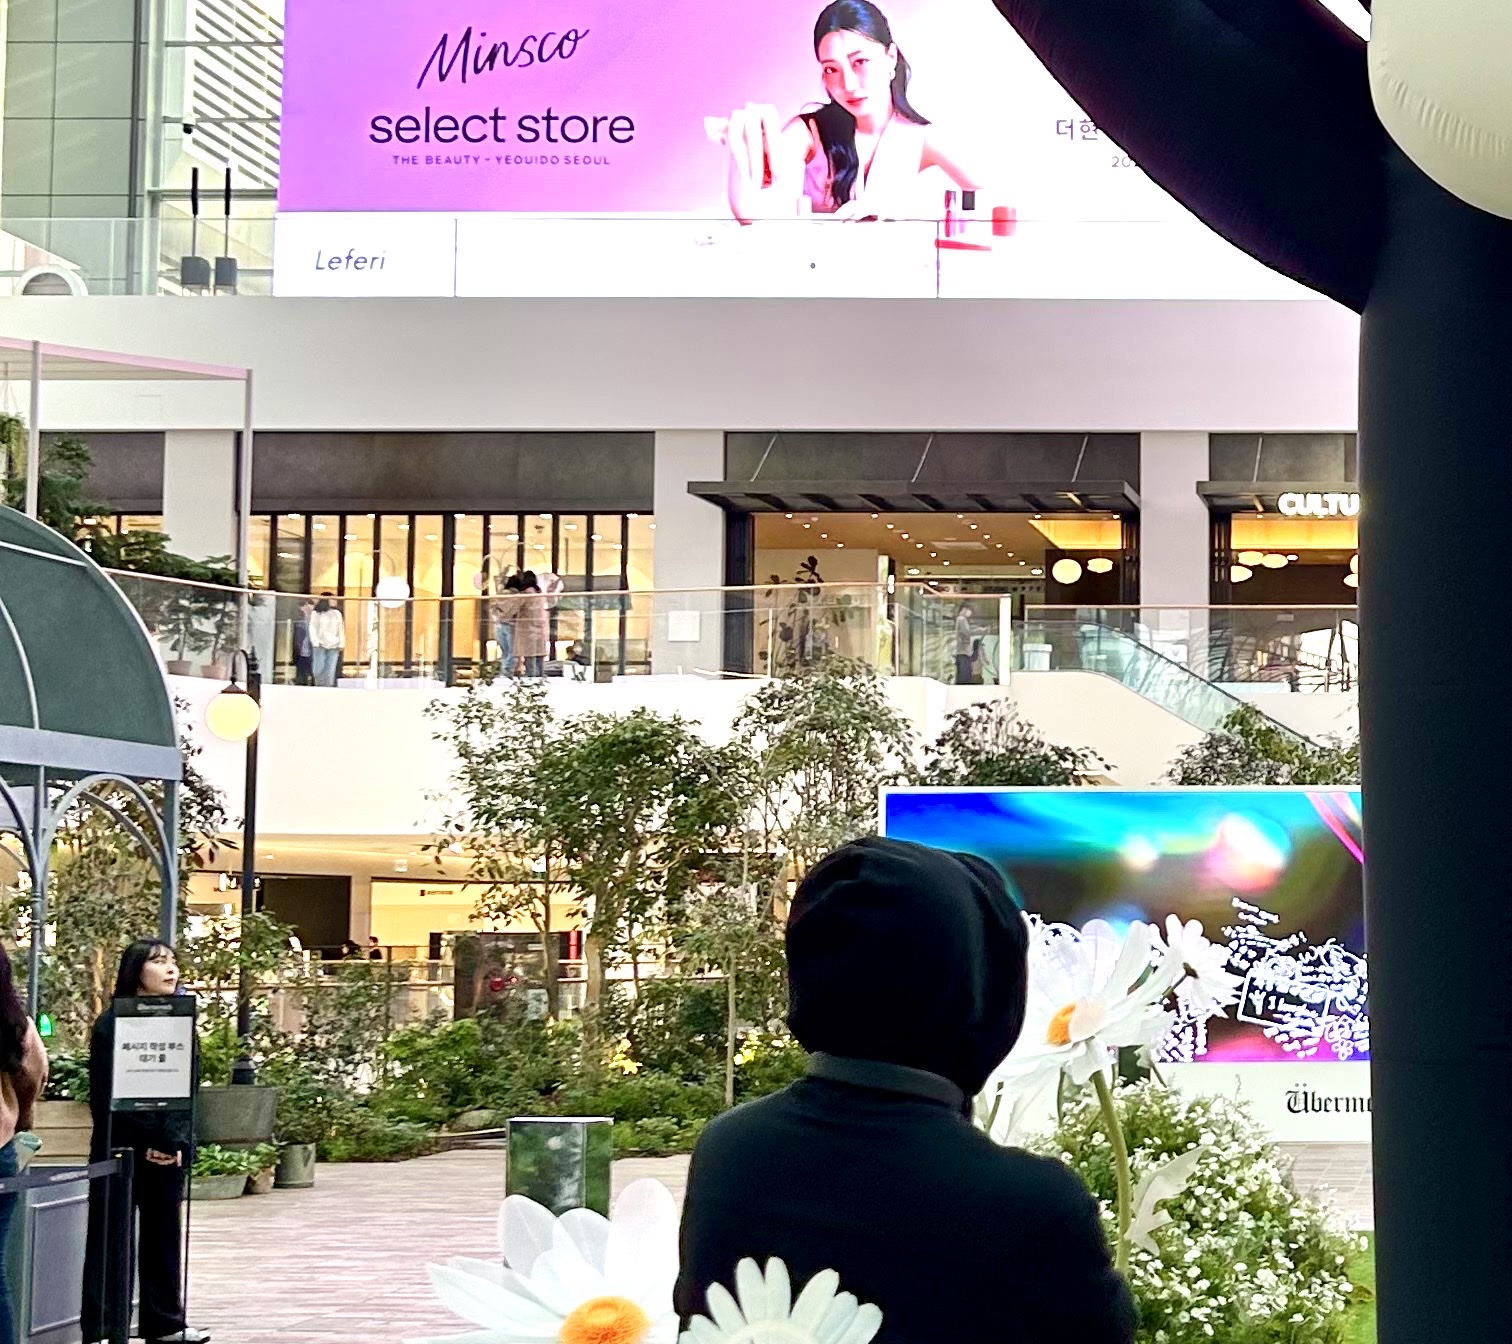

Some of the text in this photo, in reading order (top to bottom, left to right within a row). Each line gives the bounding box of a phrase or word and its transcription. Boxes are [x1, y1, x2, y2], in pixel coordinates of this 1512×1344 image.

[416, 26, 590, 89] Minsco
[369, 106, 635, 144] select store
[392, 155, 419, 166] THE
[425, 155, 481, 166] BEAUTY
[495, 155, 560, 166] YEOUIDO
[563, 155, 611, 166] SEOUL
[1111, 156, 1138, 168] 20
[315, 247, 387, 270] Leferi
[1278, 492, 1361, 516] CULTU
